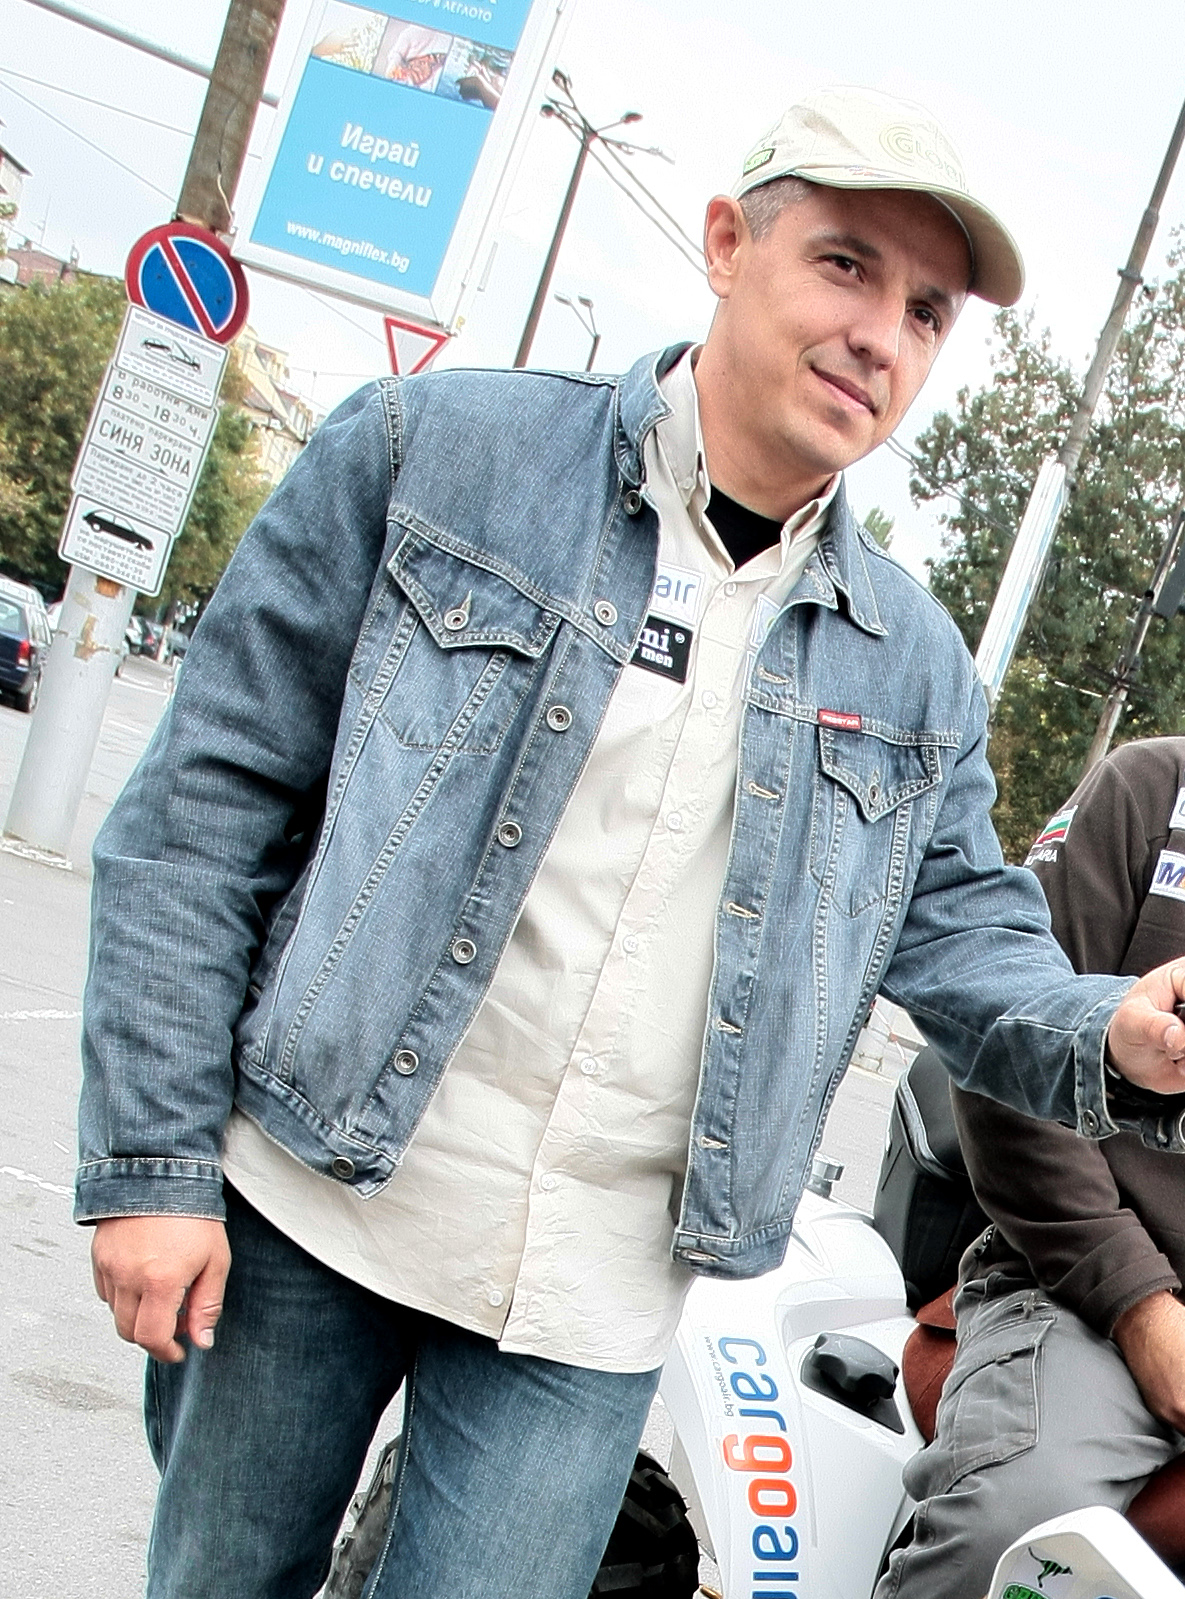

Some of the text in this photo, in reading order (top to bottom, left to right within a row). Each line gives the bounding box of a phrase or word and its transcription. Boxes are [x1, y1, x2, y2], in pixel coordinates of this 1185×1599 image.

[341, 122, 420, 168] Играй
[307, 153, 432, 208] и спечели
[286, 221, 410, 274] www.magniflex.bg
[99, 419, 191, 478] СИНЯ ЗОНА
[641, 646, 674, 668] men
